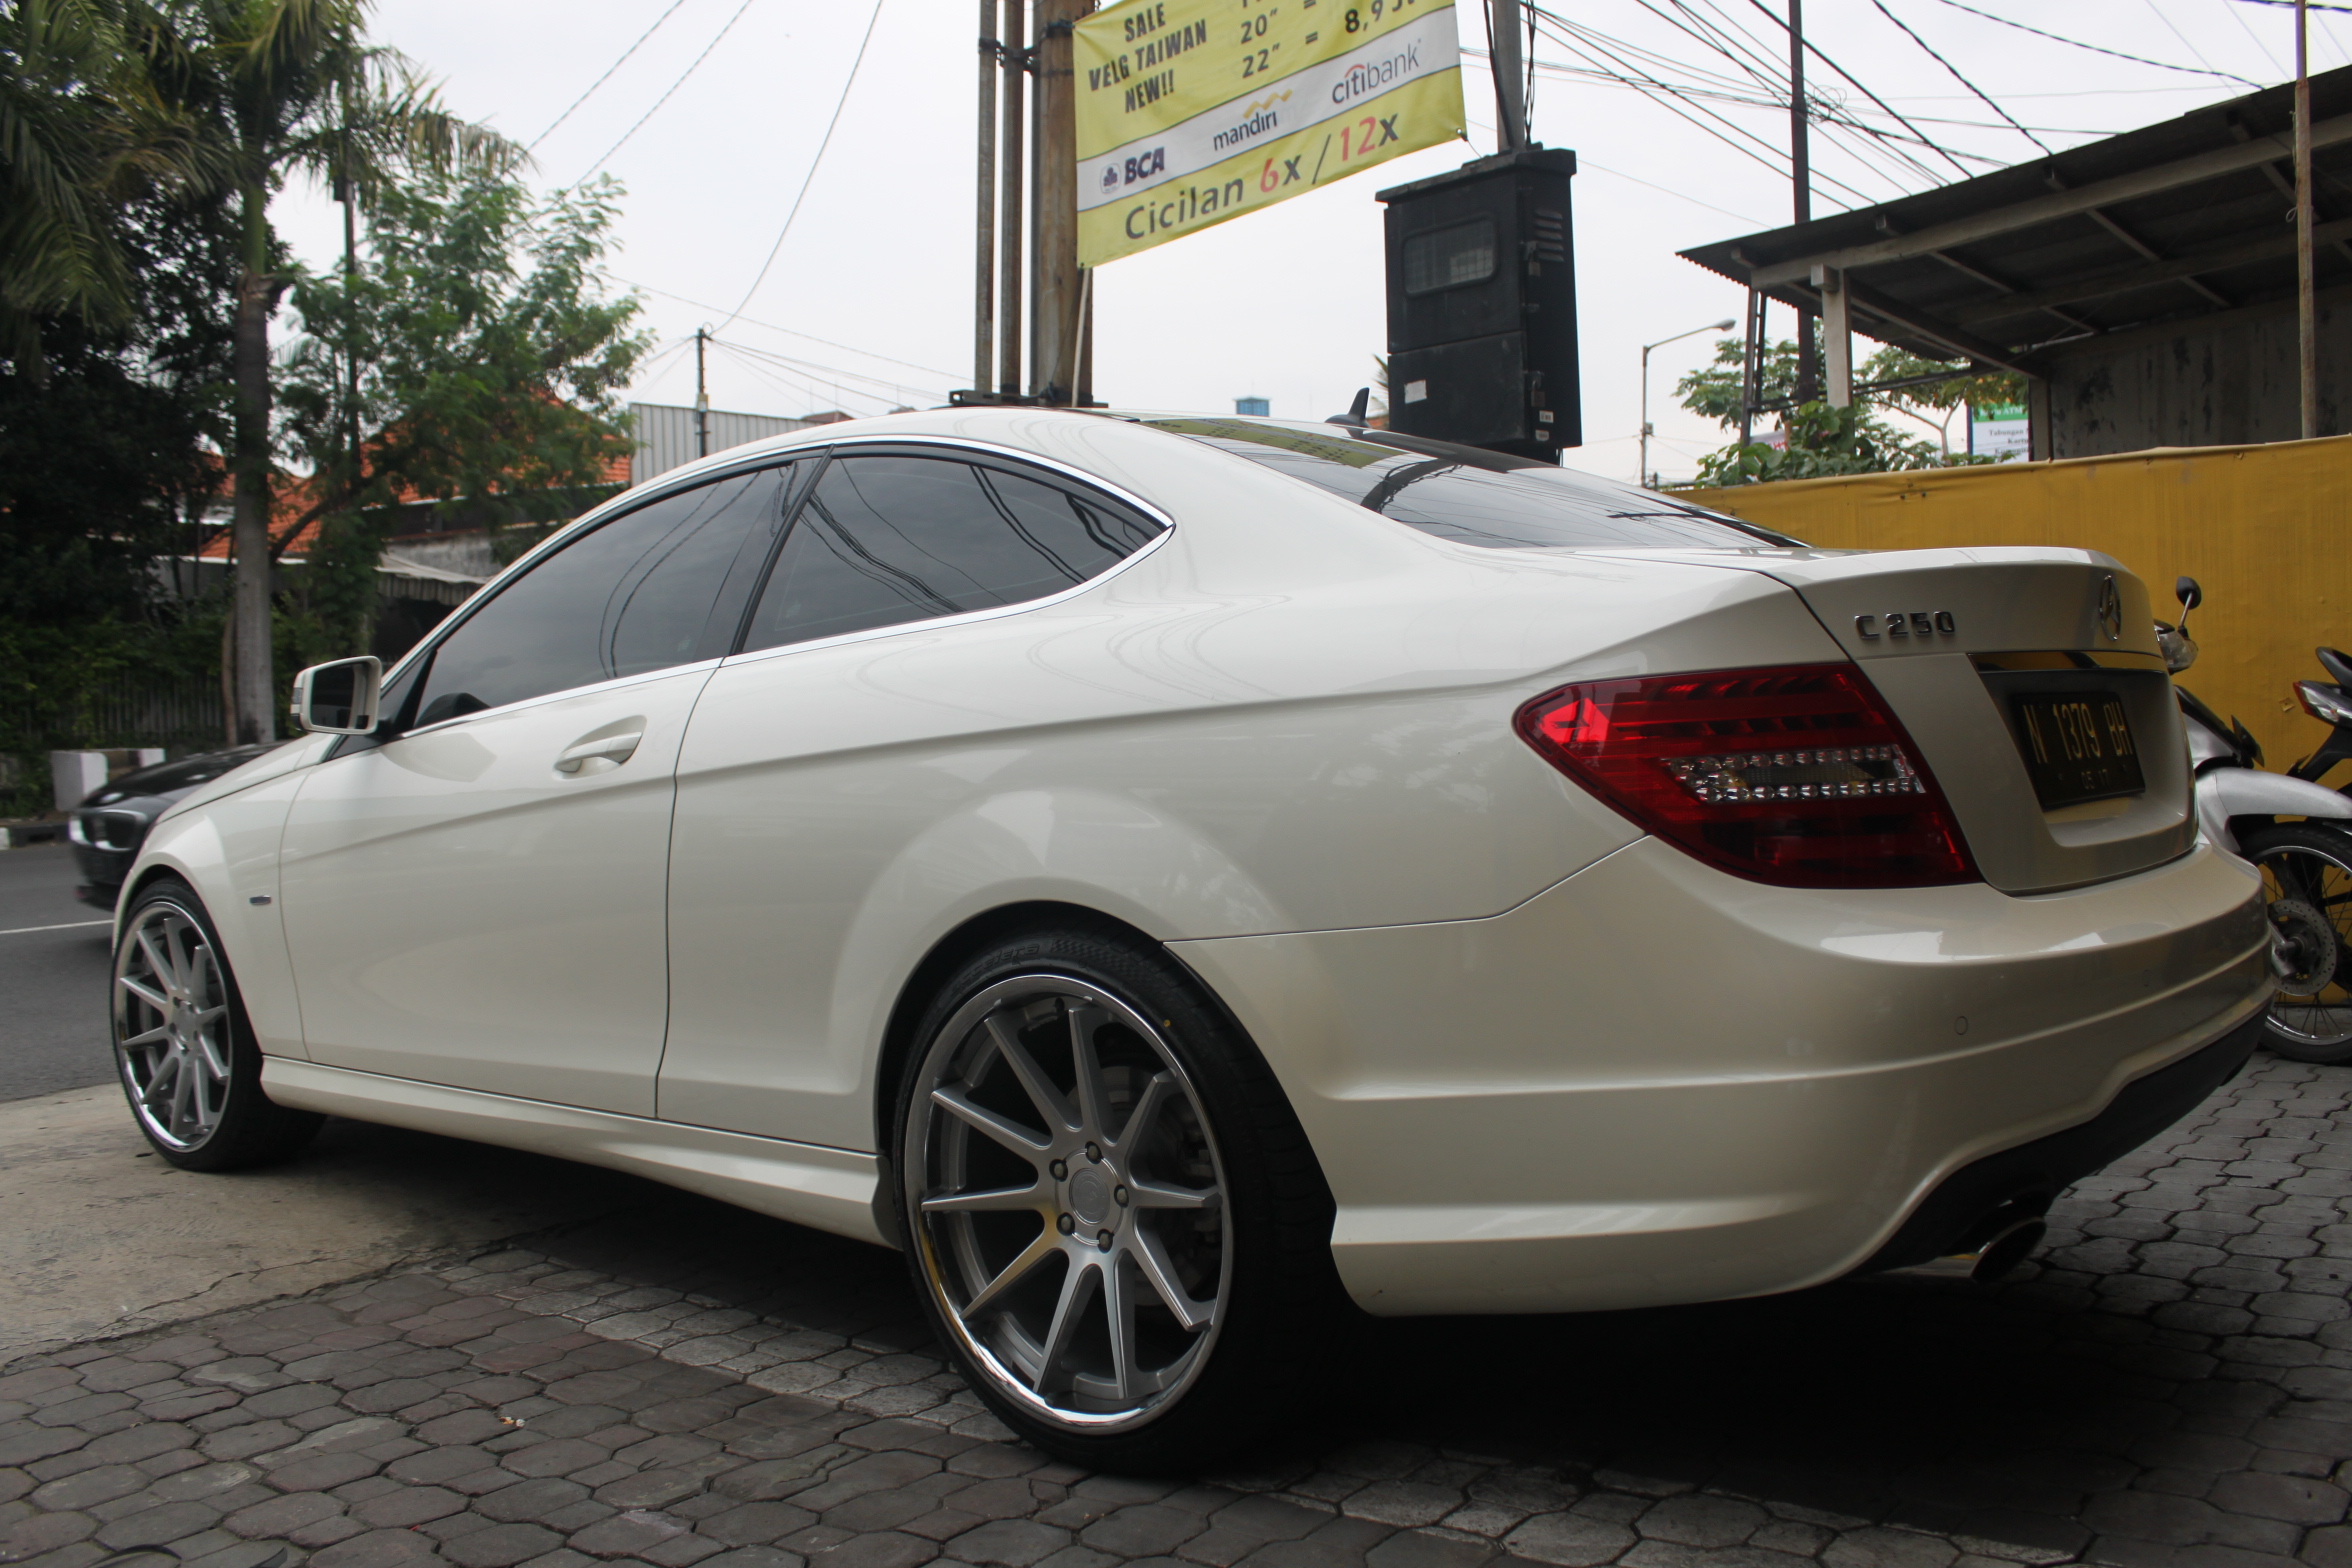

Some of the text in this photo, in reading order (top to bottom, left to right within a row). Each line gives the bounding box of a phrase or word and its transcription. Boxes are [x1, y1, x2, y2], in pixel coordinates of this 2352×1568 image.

[1124, 3, 1166, 42] SALE
[1088, 18, 1207, 92] VELG TAIWAN
[1331, 42, 1420, 104] citibank
[1125, 69, 1175, 113] NEW!!
[1213, 110, 1278, 151] mandiri
[1124, 147, 1165, 185] BCA
[1124, 177, 1244, 240] Cicilan
[1259, 154, 1303, 193] 6x
[1340, 113, 1399, 162] 12x
[1854, 611, 1956, 640] C 250
[2022, 701, 2134, 765] N 1379 BH
